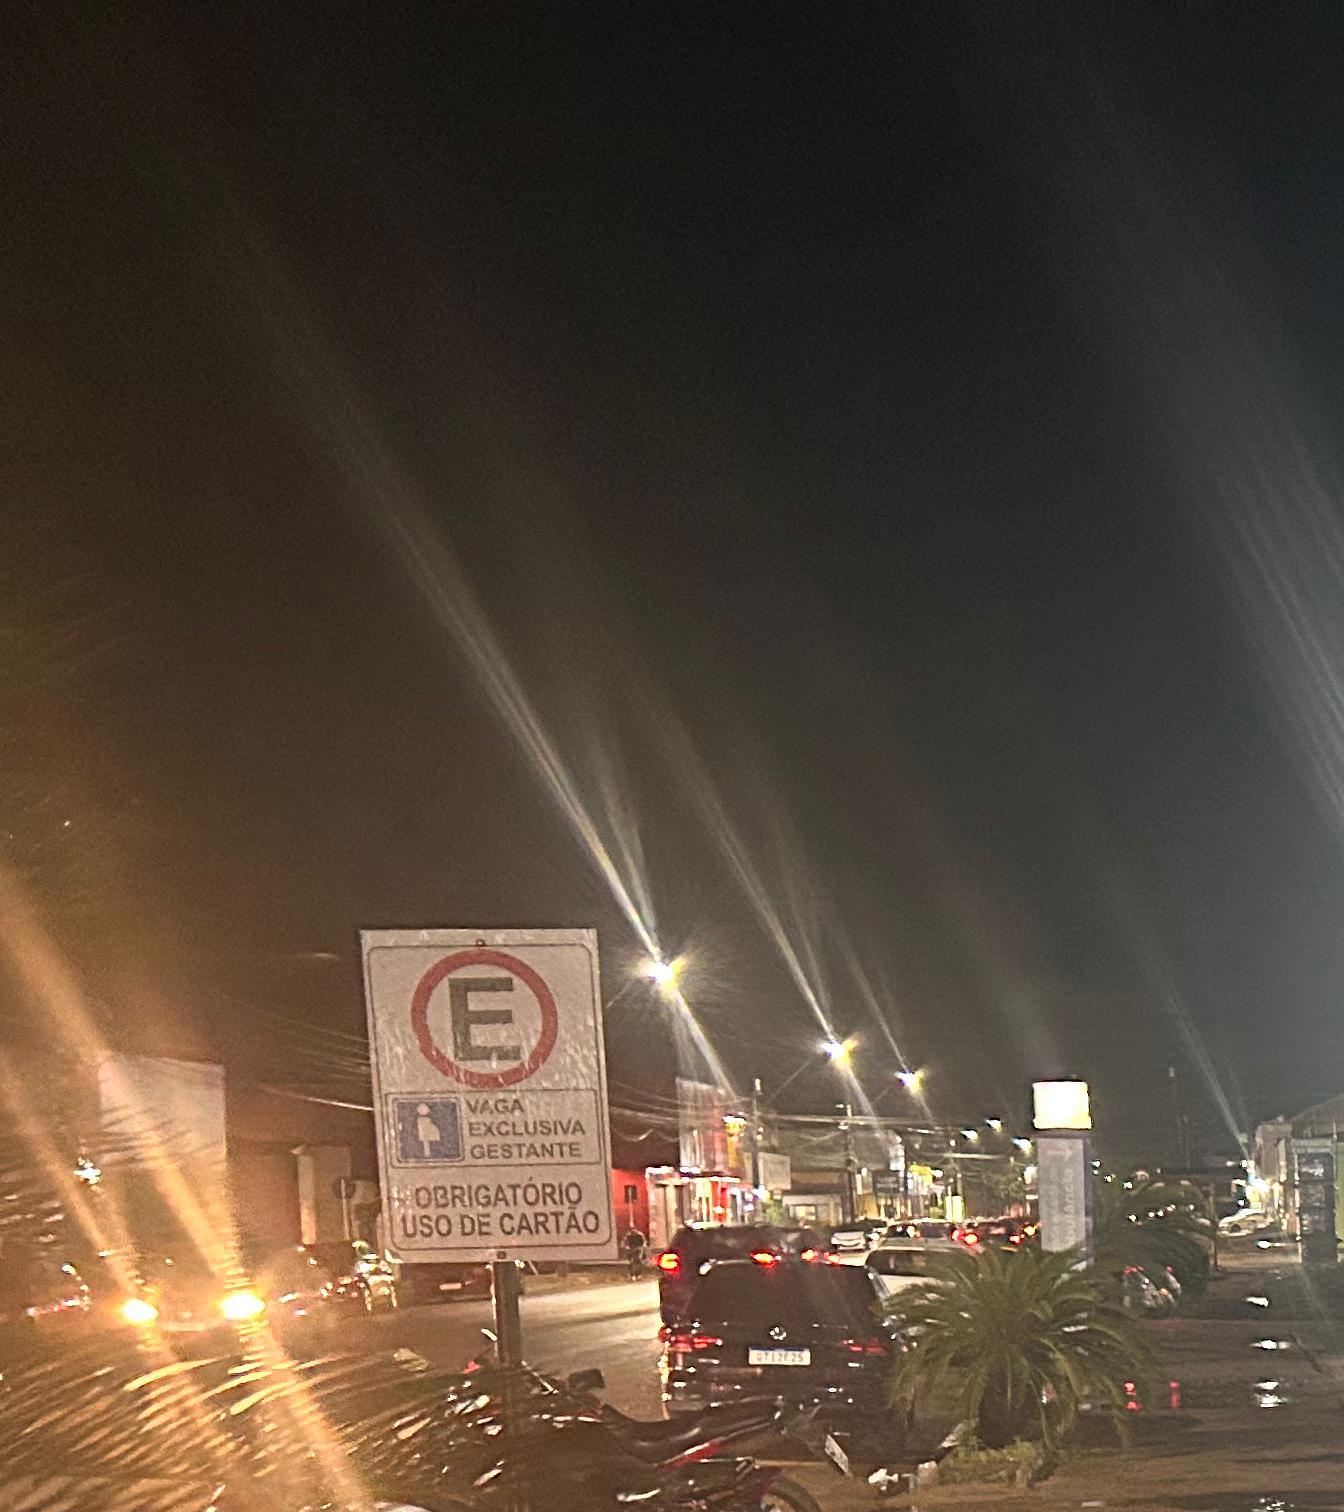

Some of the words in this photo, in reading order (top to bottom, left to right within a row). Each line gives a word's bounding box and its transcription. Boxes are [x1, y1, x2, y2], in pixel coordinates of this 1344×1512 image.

[448, 977, 521, 1062] E
[465, 1098, 525, 1116] VAGA
[468, 1119, 586, 1138] EXCLUSIVA
[470, 1142, 583, 1160] GESTANTE
[414, 1177, 583, 1209] OBRIGATÓRIO
[402, 1214, 452, 1238] USO
[460, 1213, 491, 1237] DE
[500, 1205, 601, 1236] CARTÃO
